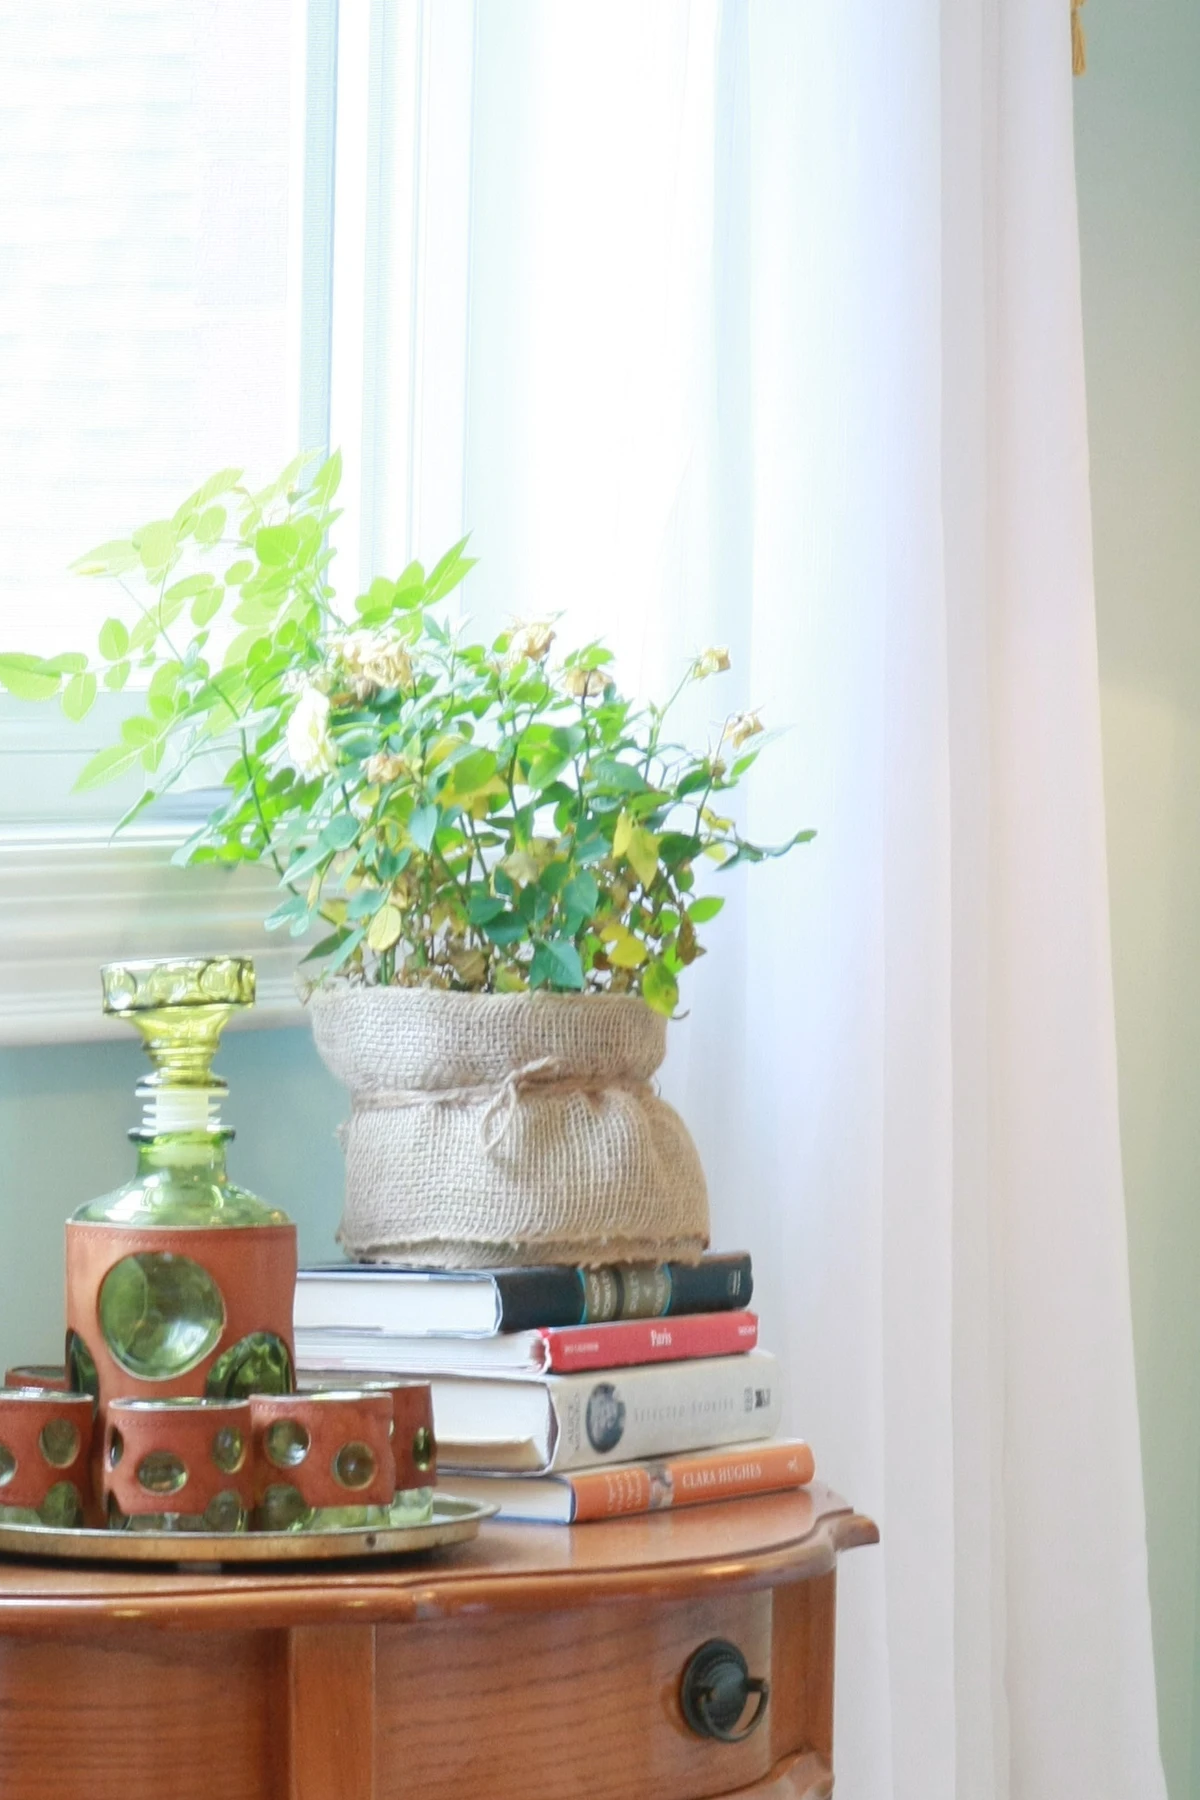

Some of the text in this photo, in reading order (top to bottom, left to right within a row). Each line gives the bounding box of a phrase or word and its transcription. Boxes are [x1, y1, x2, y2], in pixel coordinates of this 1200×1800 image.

[650, 1328, 673, 1347] Paris
[681, 1463, 763, 1489] CLARA HUGHES
